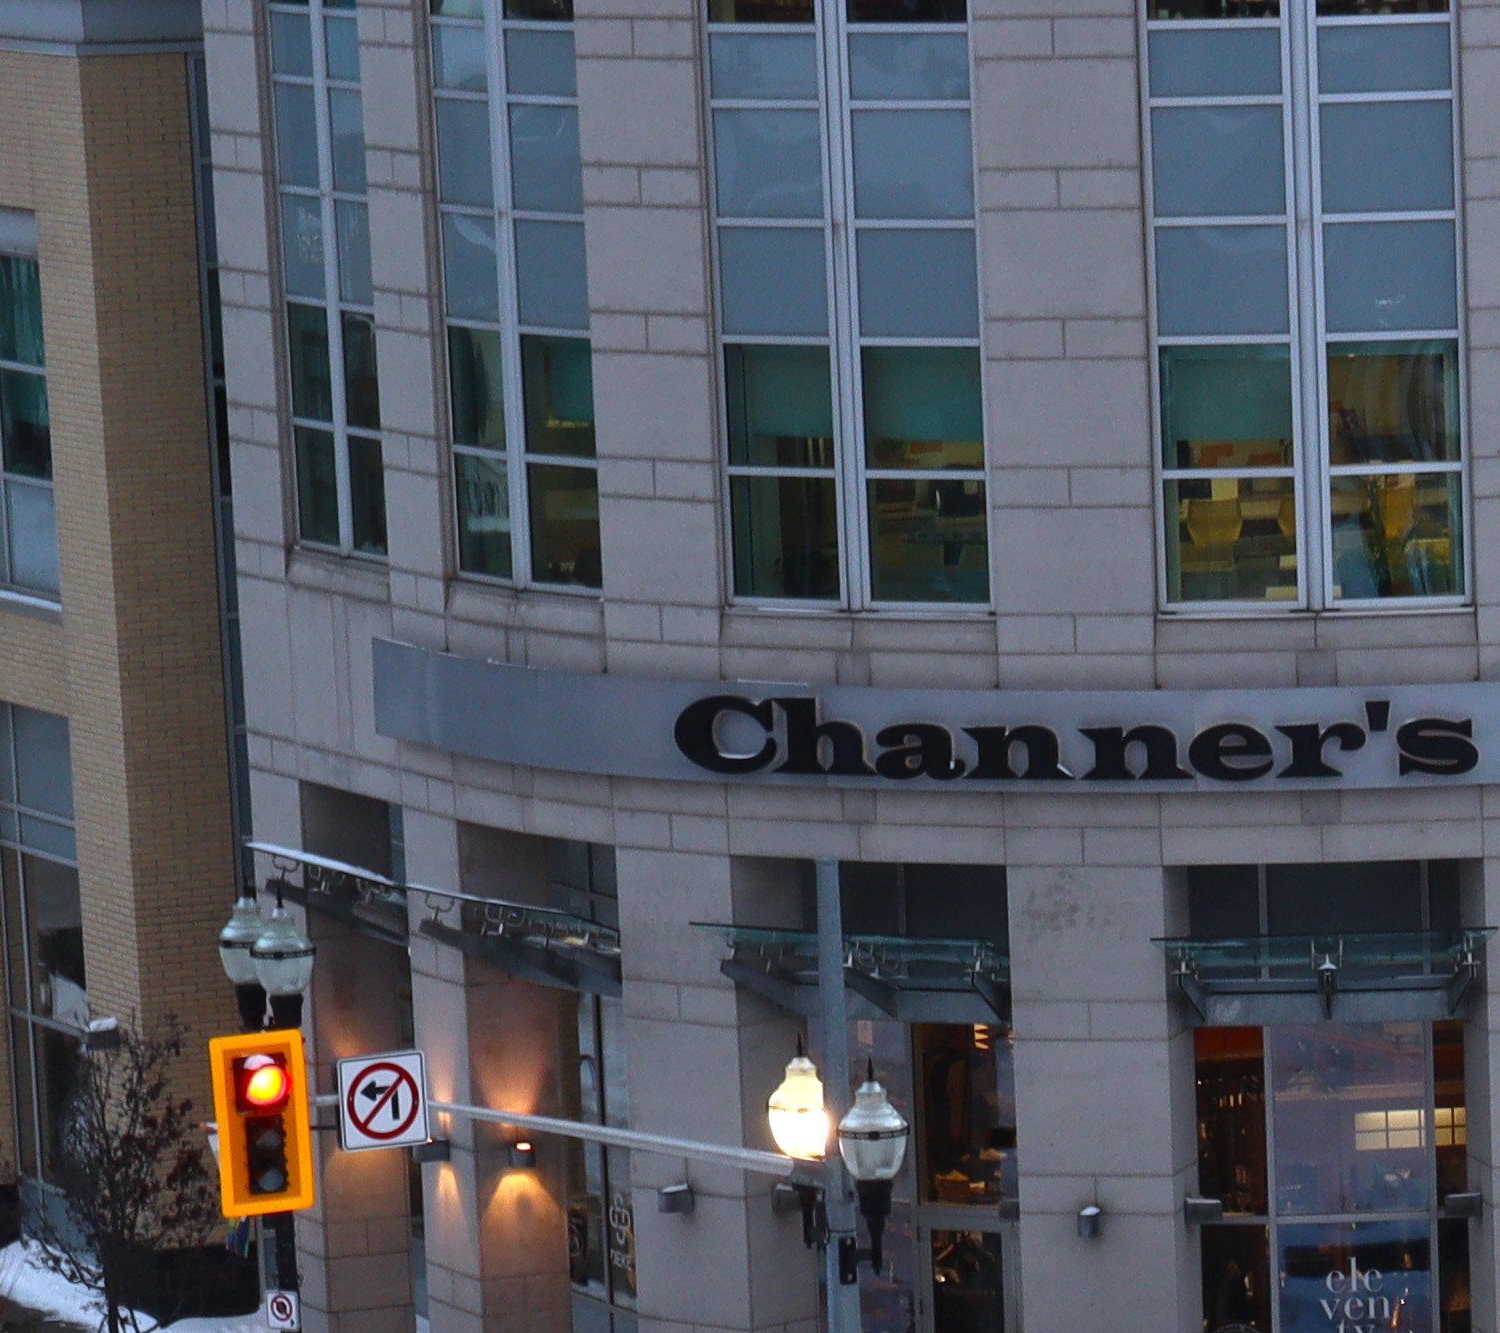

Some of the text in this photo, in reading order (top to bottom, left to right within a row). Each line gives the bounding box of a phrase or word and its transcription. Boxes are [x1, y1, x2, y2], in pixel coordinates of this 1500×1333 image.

[673, 694, 1480, 781] Channer's
[1326, 1256, 1383, 1293] ele
[1320, 1296, 1390, 1321] ven
